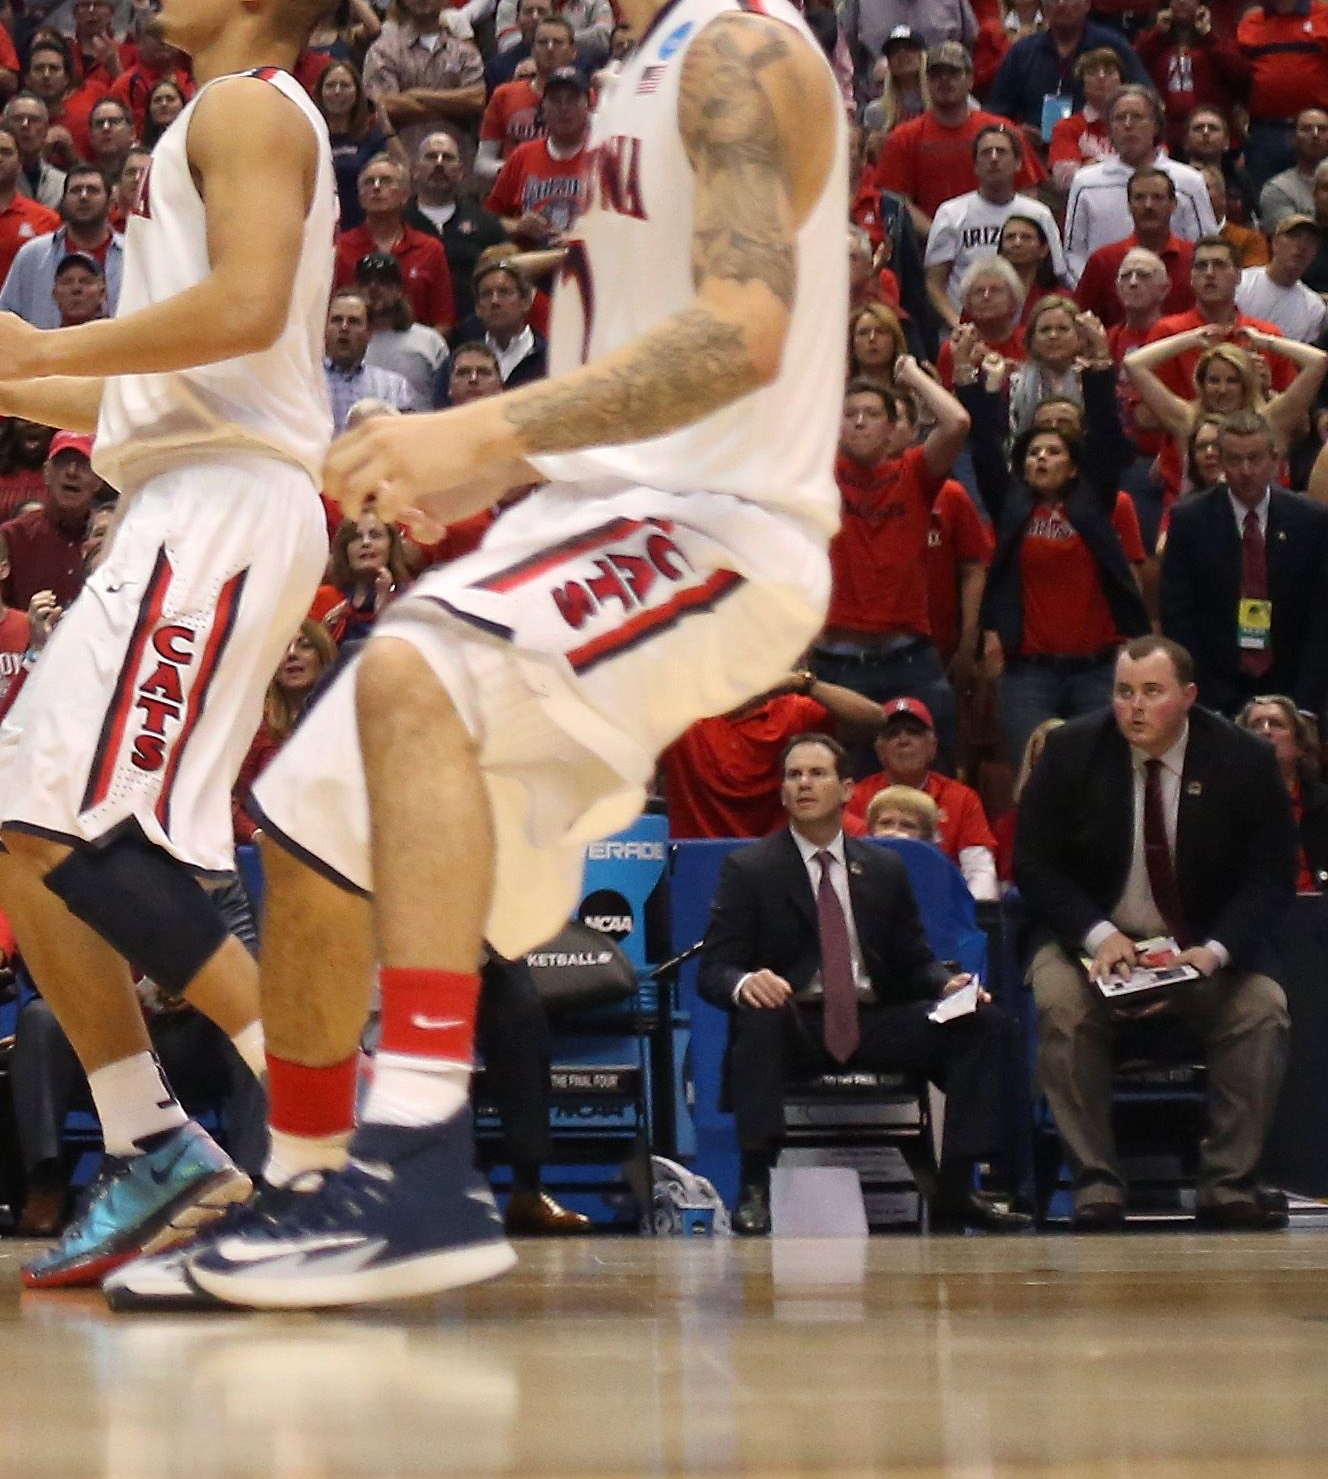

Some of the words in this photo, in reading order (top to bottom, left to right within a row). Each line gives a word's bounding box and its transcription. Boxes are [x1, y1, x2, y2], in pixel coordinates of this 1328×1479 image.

[961, 226, 1005, 250] ARIZ
[131, 625, 195, 772] CATS
[583, 841, 665, 862] ERADE
[526, 951, 597, 968] KETBALL
